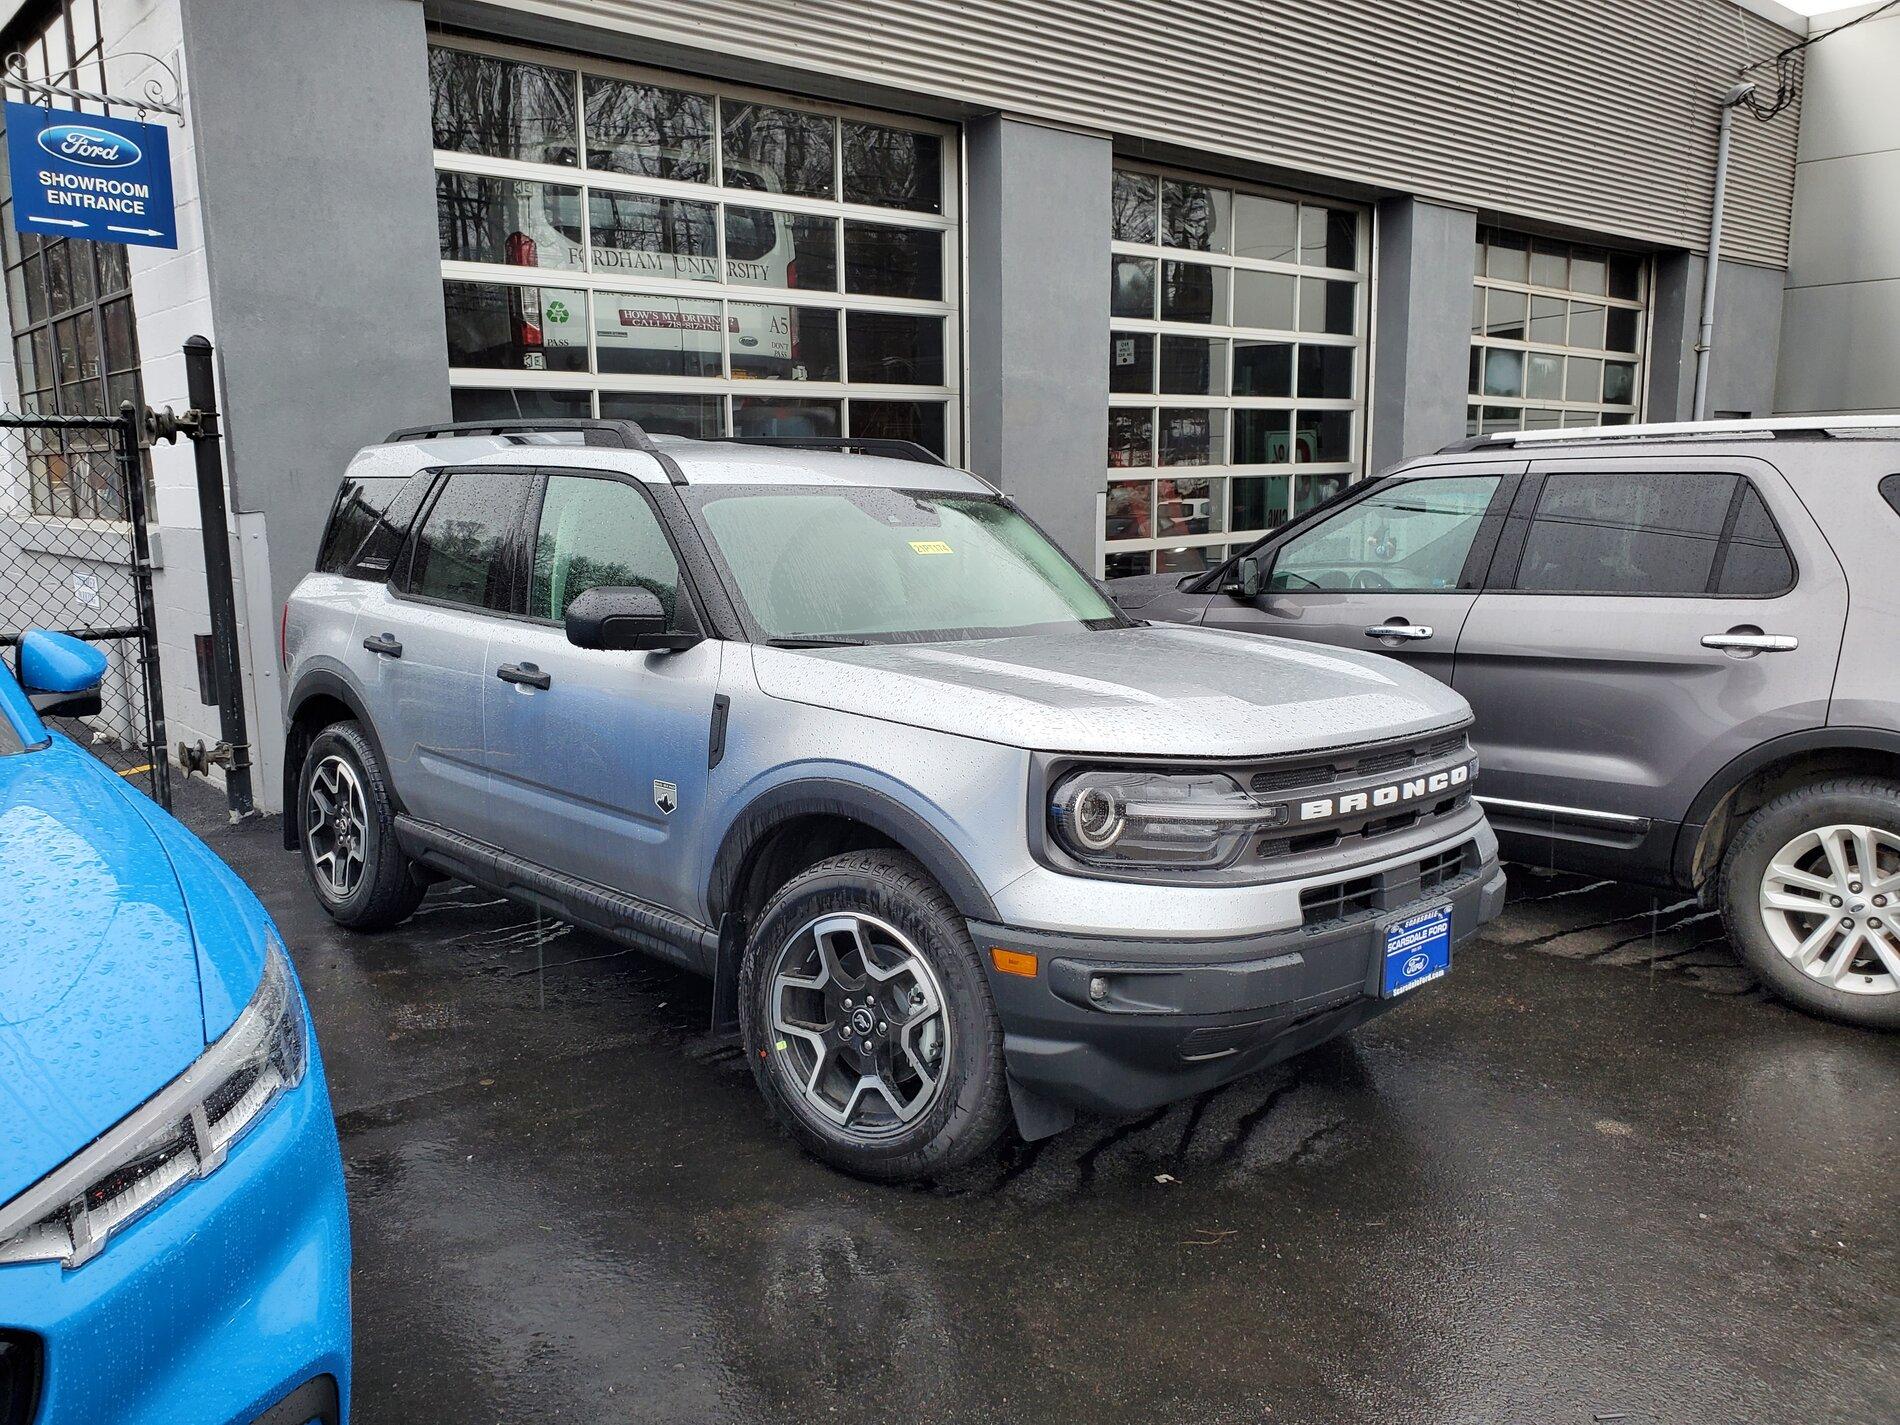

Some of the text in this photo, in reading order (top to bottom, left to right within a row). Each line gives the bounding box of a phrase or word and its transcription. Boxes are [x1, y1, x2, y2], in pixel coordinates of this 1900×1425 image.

[61, 132, 120, 161] Ford
[39, 170, 150, 199] SHOWROOM
[47, 189, 146, 216] ENTRANCE
[674, 256, 770, 281] UNIVRSITY
[623, 310, 735, 327] HOW'S MY DRIVIN?
[668, 321, 721, 333] 718-817-INF
[769, 315, 789, 335] A5
[547, 338, 569, 347] PASS
[1301, 765, 1468, 820] BRONCO
[1387, 931, 1427, 953] SCARSDALE
[1428, 922, 1448, 937] FORD
[1406, 957, 1425, 974] Ford
